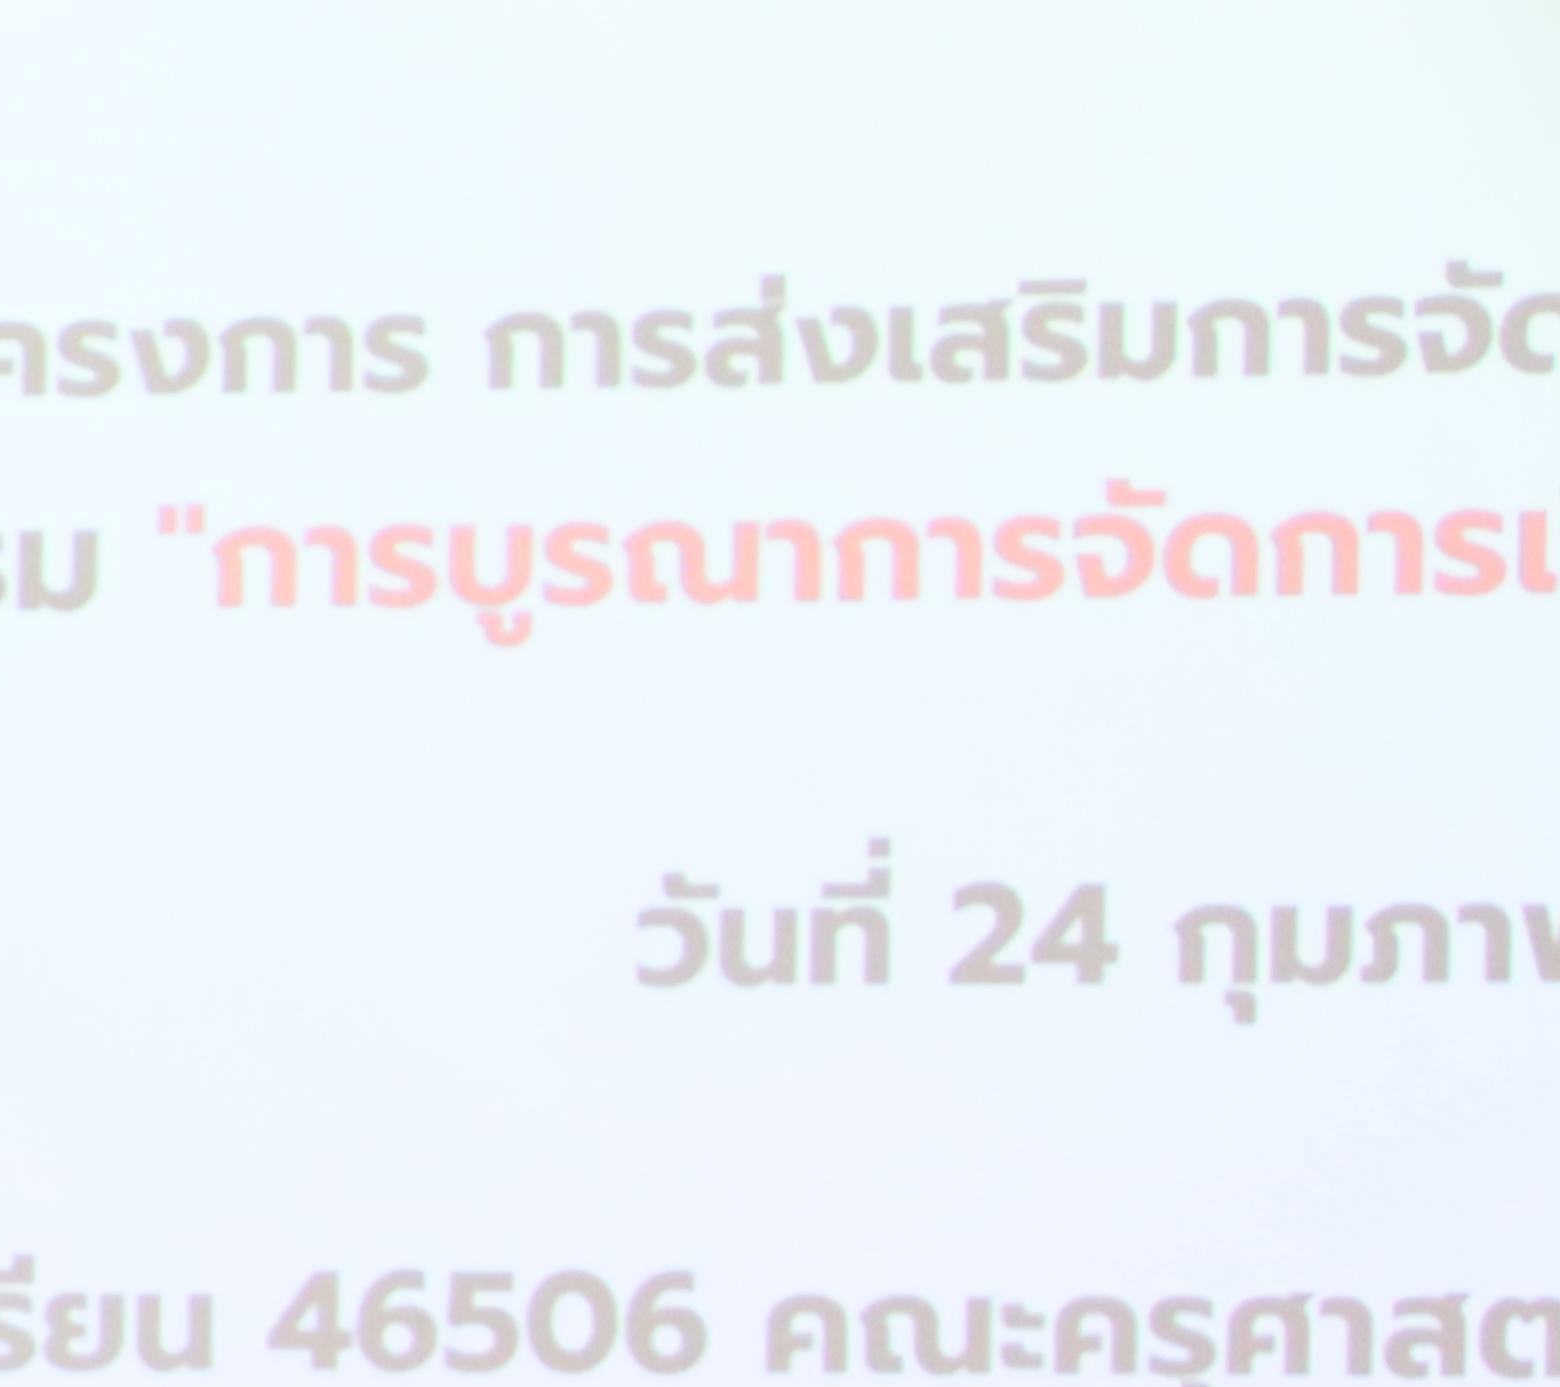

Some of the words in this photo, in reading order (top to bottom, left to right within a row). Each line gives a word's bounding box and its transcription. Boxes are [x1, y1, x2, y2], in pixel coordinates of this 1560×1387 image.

[483, 260, 1560, 389] การส่งเสริมการจัด
[635, 838, 891, 988] วันที่
[948, 880, 1119, 985] 24
[265, 1268, 707, 1376] 46506
